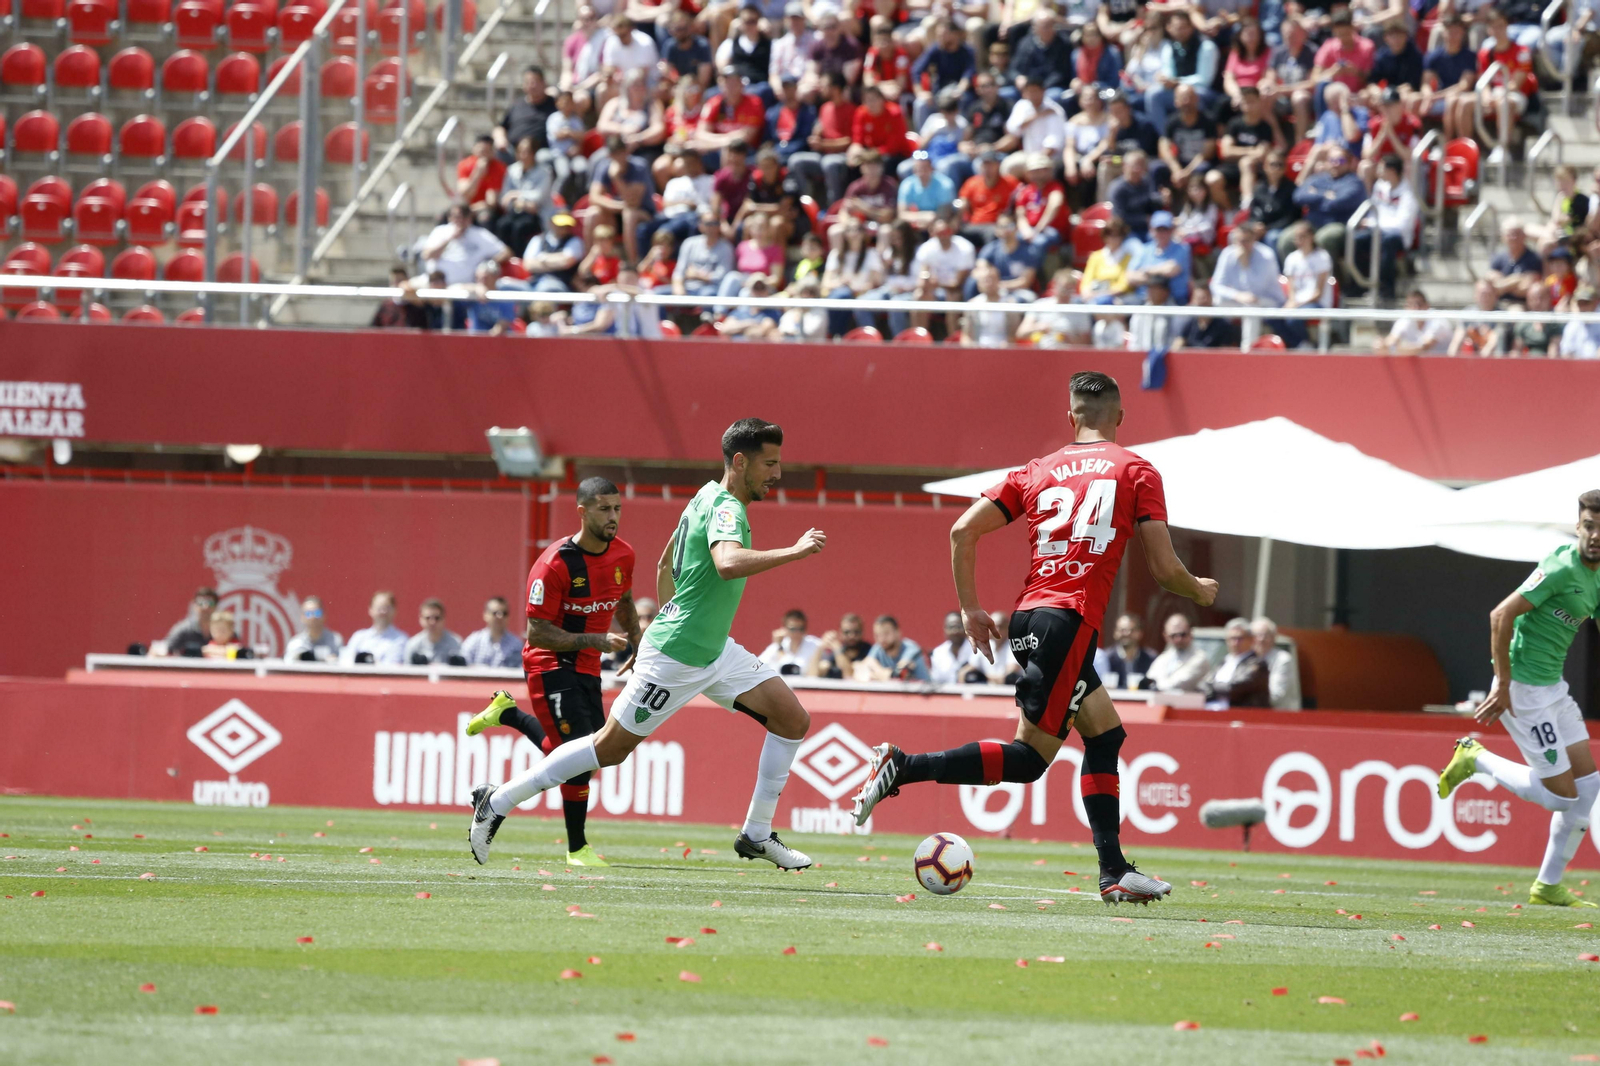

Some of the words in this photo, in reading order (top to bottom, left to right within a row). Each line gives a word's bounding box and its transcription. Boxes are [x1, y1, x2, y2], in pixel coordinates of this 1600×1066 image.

[1050, 458, 1115, 482] VALJENT
[1037, 479, 1117, 557] 24
[548, 692, 563, 719] 7
[638, 682, 671, 712] 10
[1068, 679, 1088, 712] 2
[1531, 721, 1557, 748] 18
[373, 711, 685, 818] umbro.om
[192, 774, 270, 808] umbro
[1138, 781, 1192, 808] HOTELS
[1455, 799, 1511, 825] HOTELS
